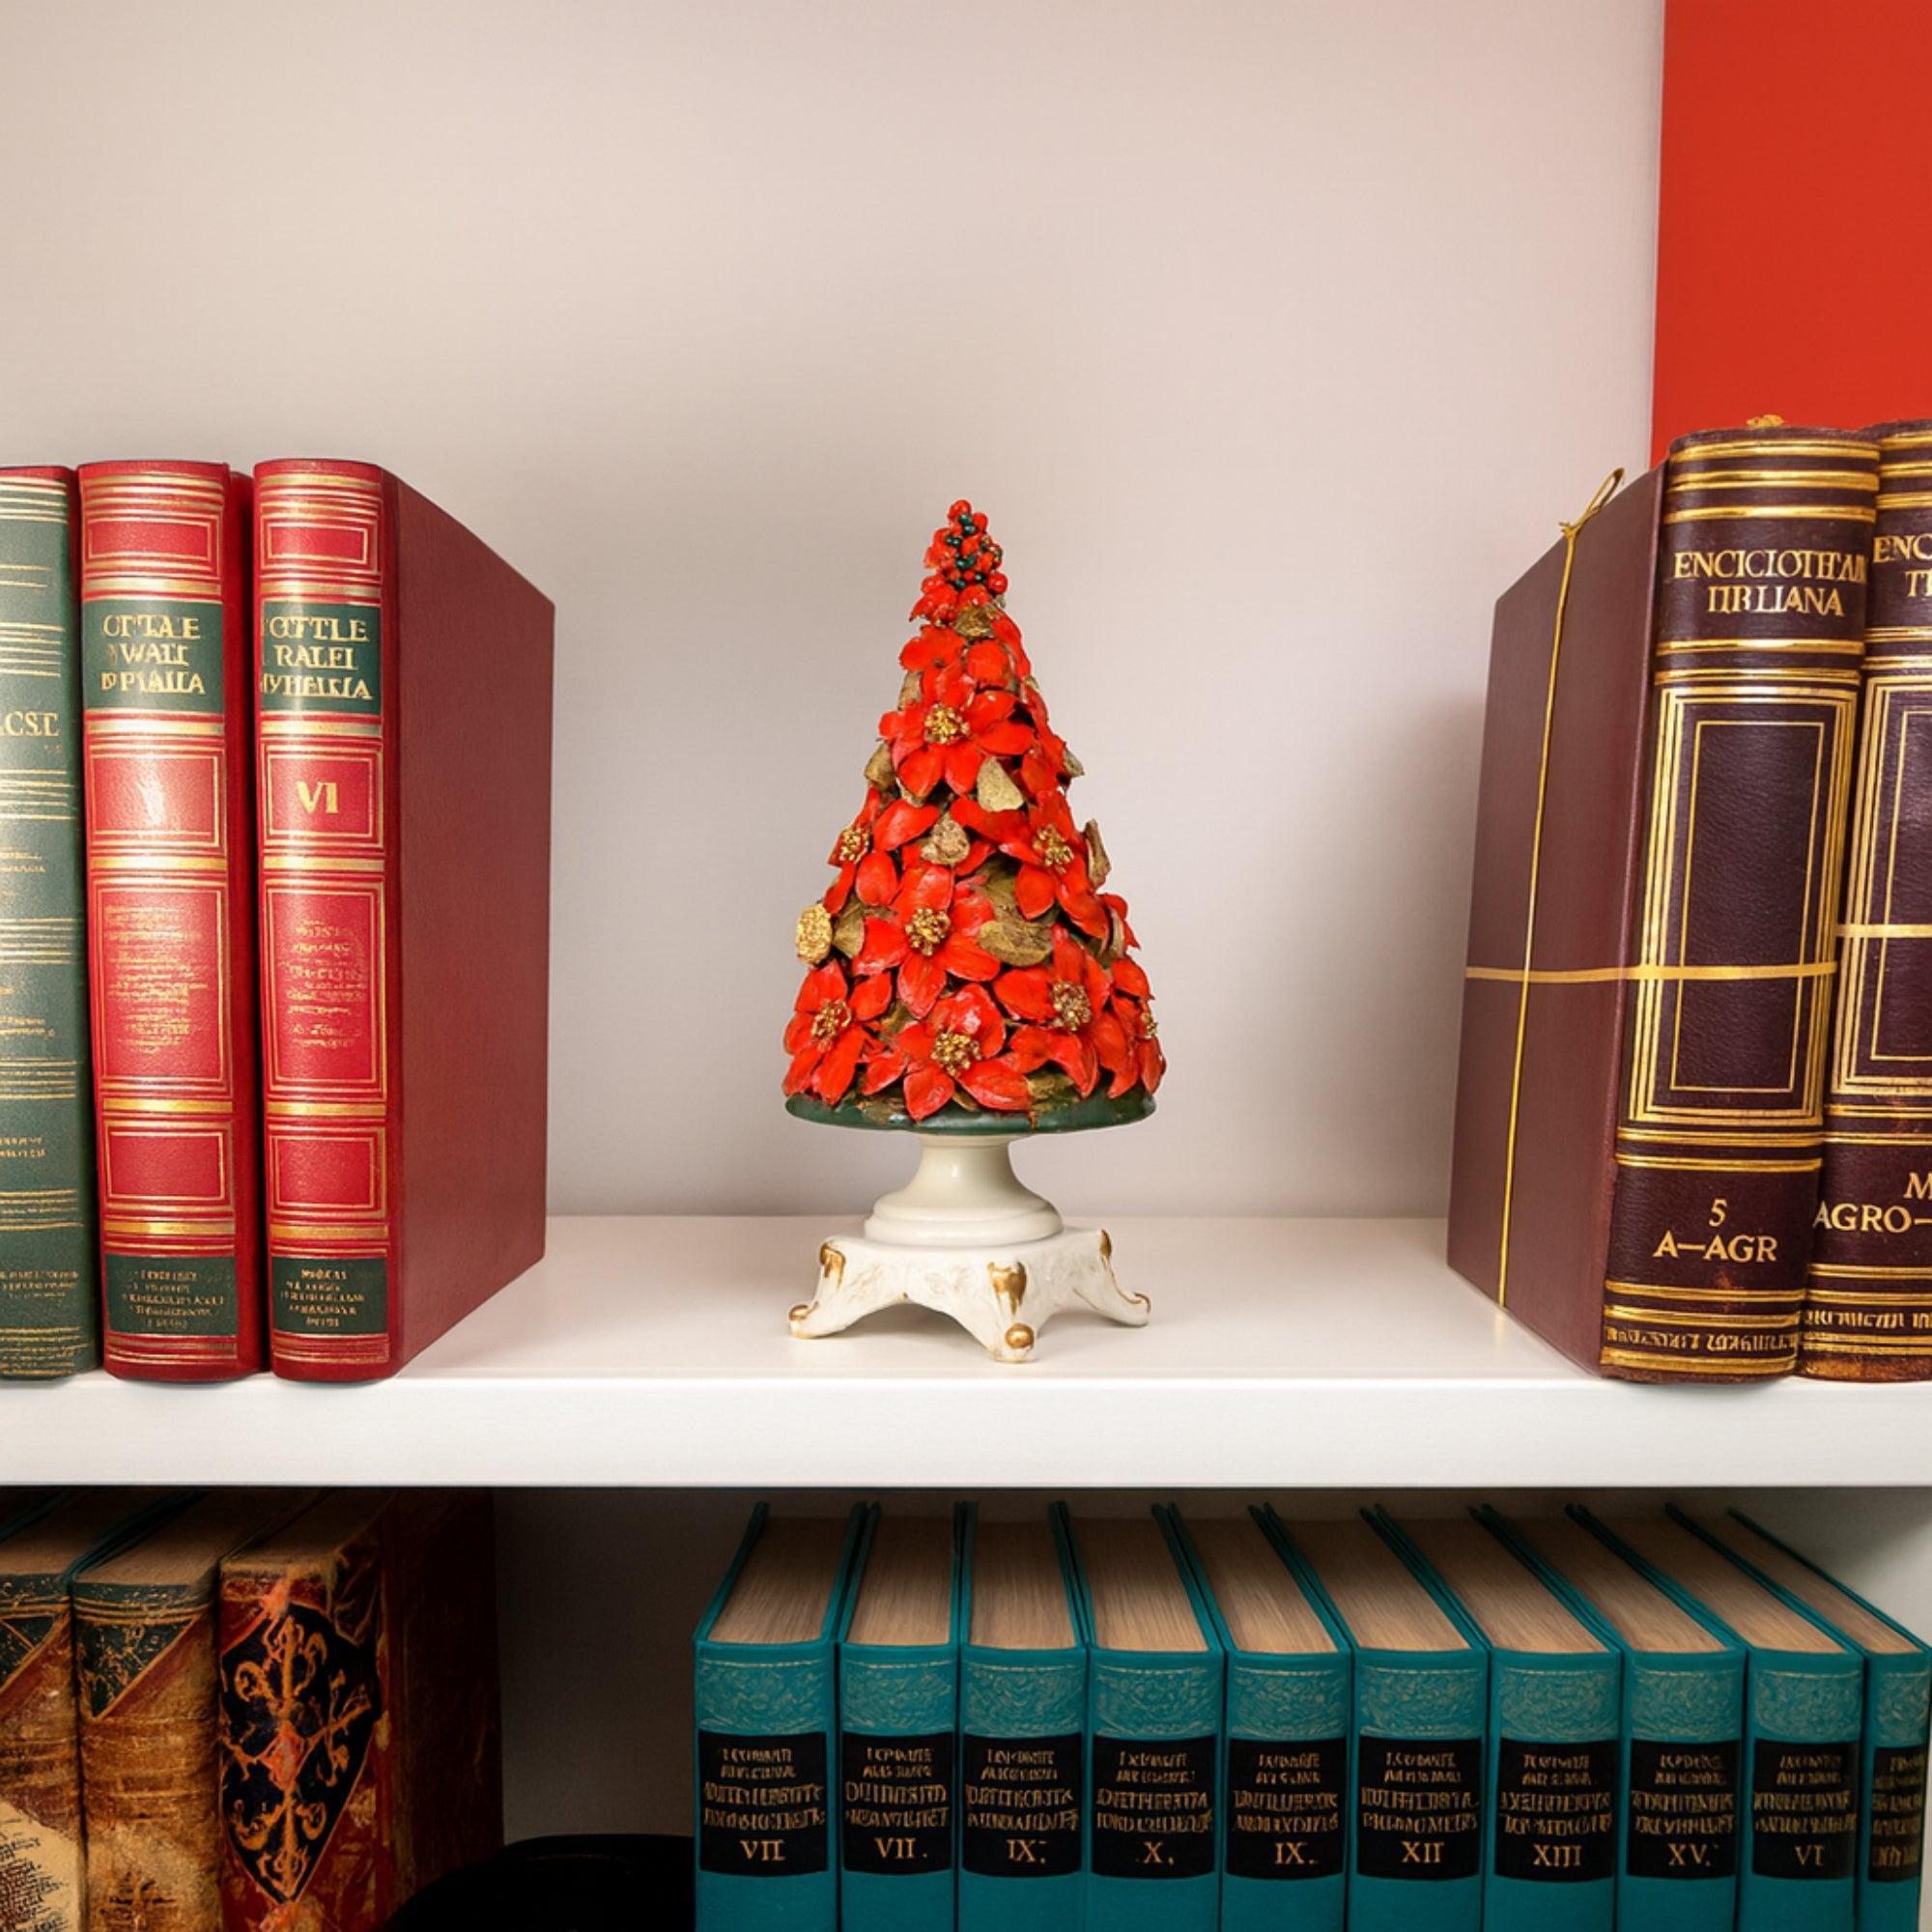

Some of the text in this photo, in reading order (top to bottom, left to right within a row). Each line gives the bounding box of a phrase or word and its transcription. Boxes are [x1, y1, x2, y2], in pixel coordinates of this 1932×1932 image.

[297, 780, 339, 813] VI
[1708, 1198, 1728, 1228] 5
[1402, 1840, 1445, 1864] XII
